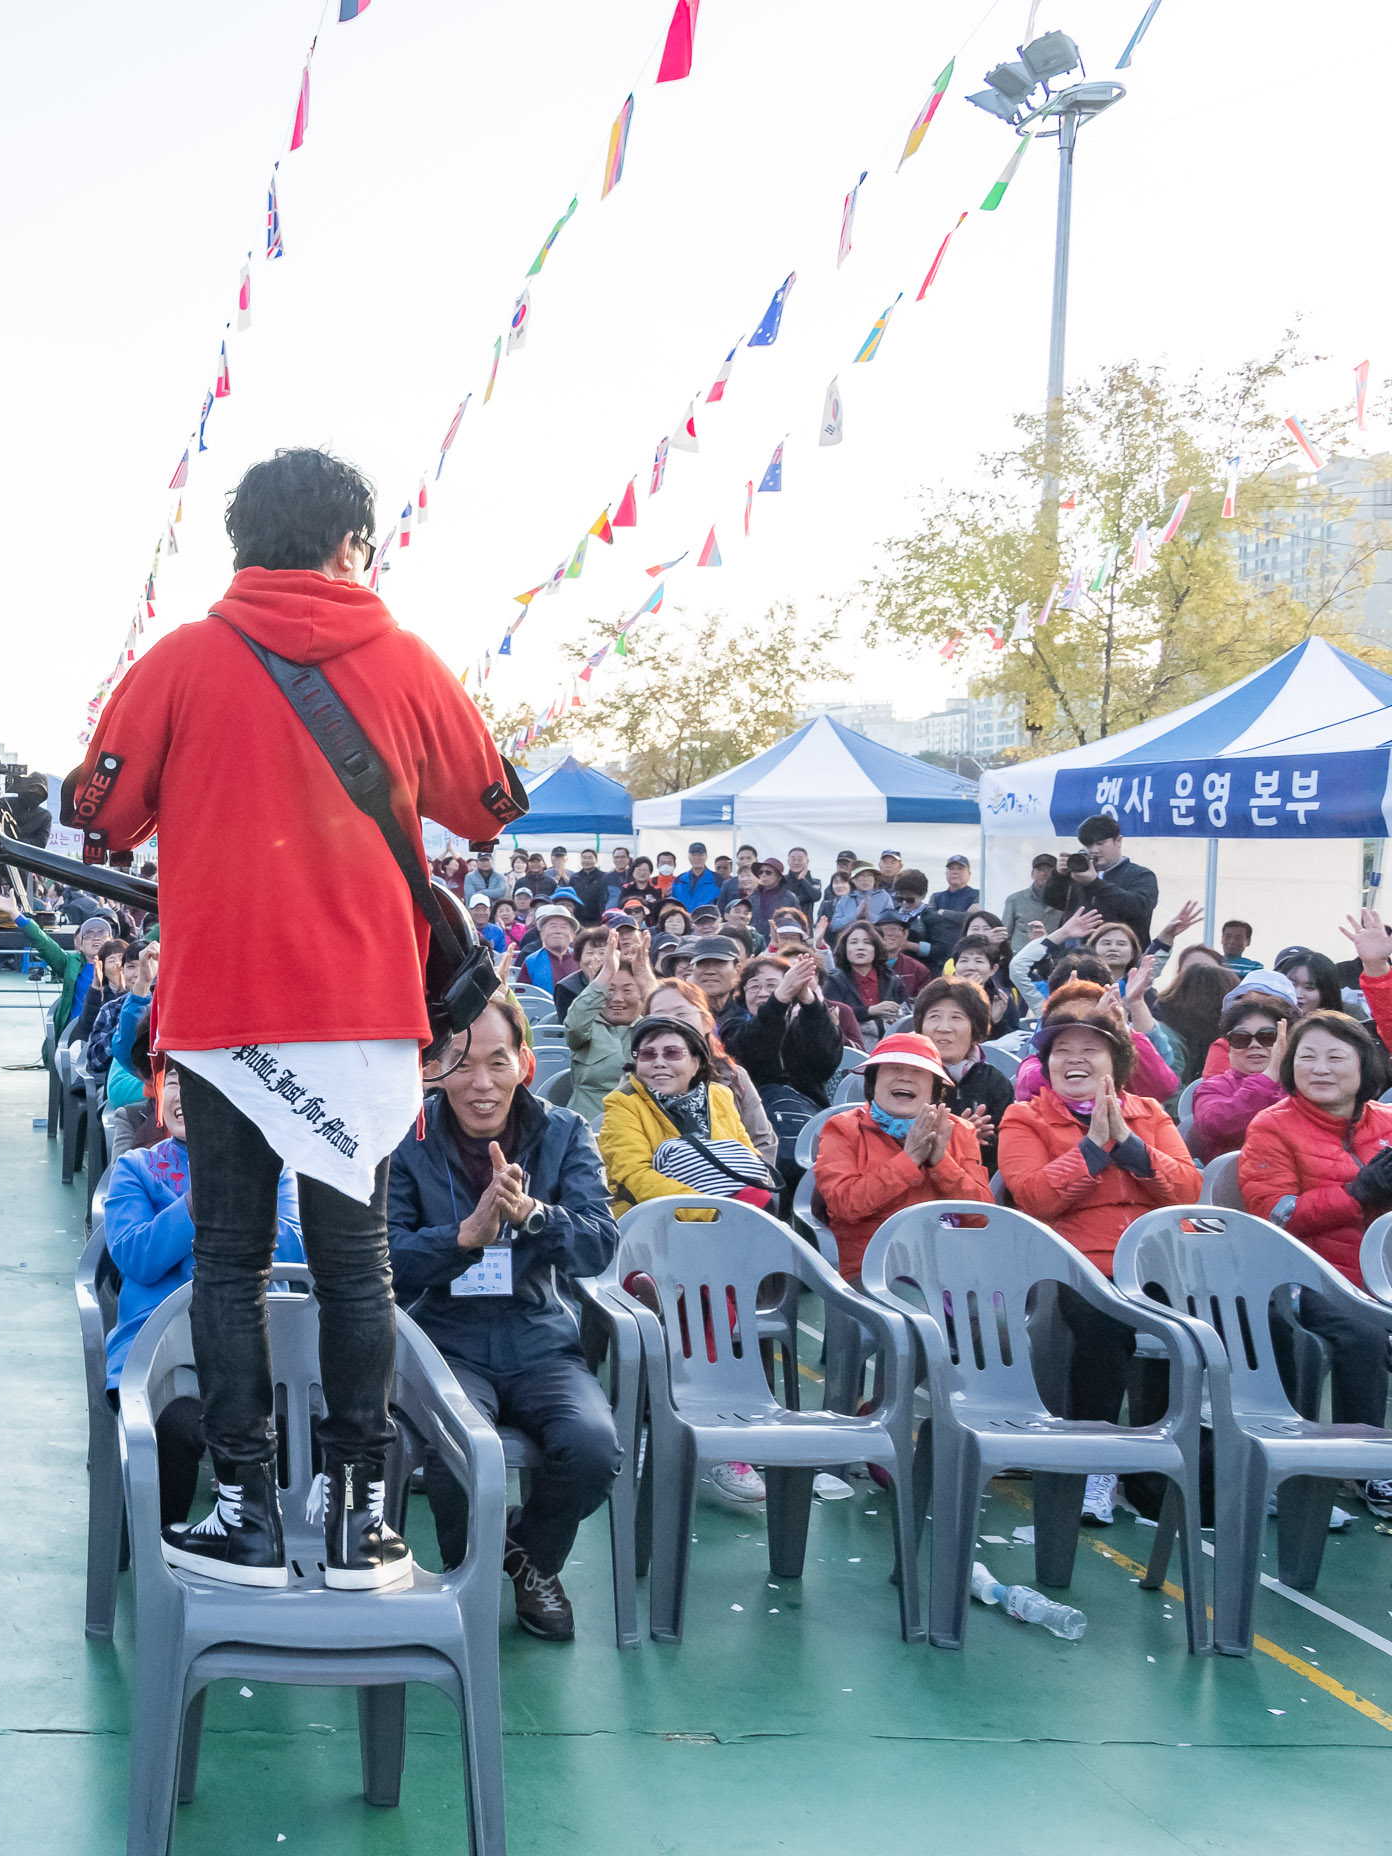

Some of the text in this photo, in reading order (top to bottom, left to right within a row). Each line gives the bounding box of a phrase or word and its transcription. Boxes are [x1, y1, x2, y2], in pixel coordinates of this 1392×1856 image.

[72, 772, 112, 828] TORE
[1095, 775, 1154, 823] 행사
[1169, 772, 1232, 828] 운영
[1249, 769, 1321, 827] 본부
[266, 1068, 309, 1106] Just
[290, 1096, 326, 1125] For
[312, 1117, 359, 1159] Mania
